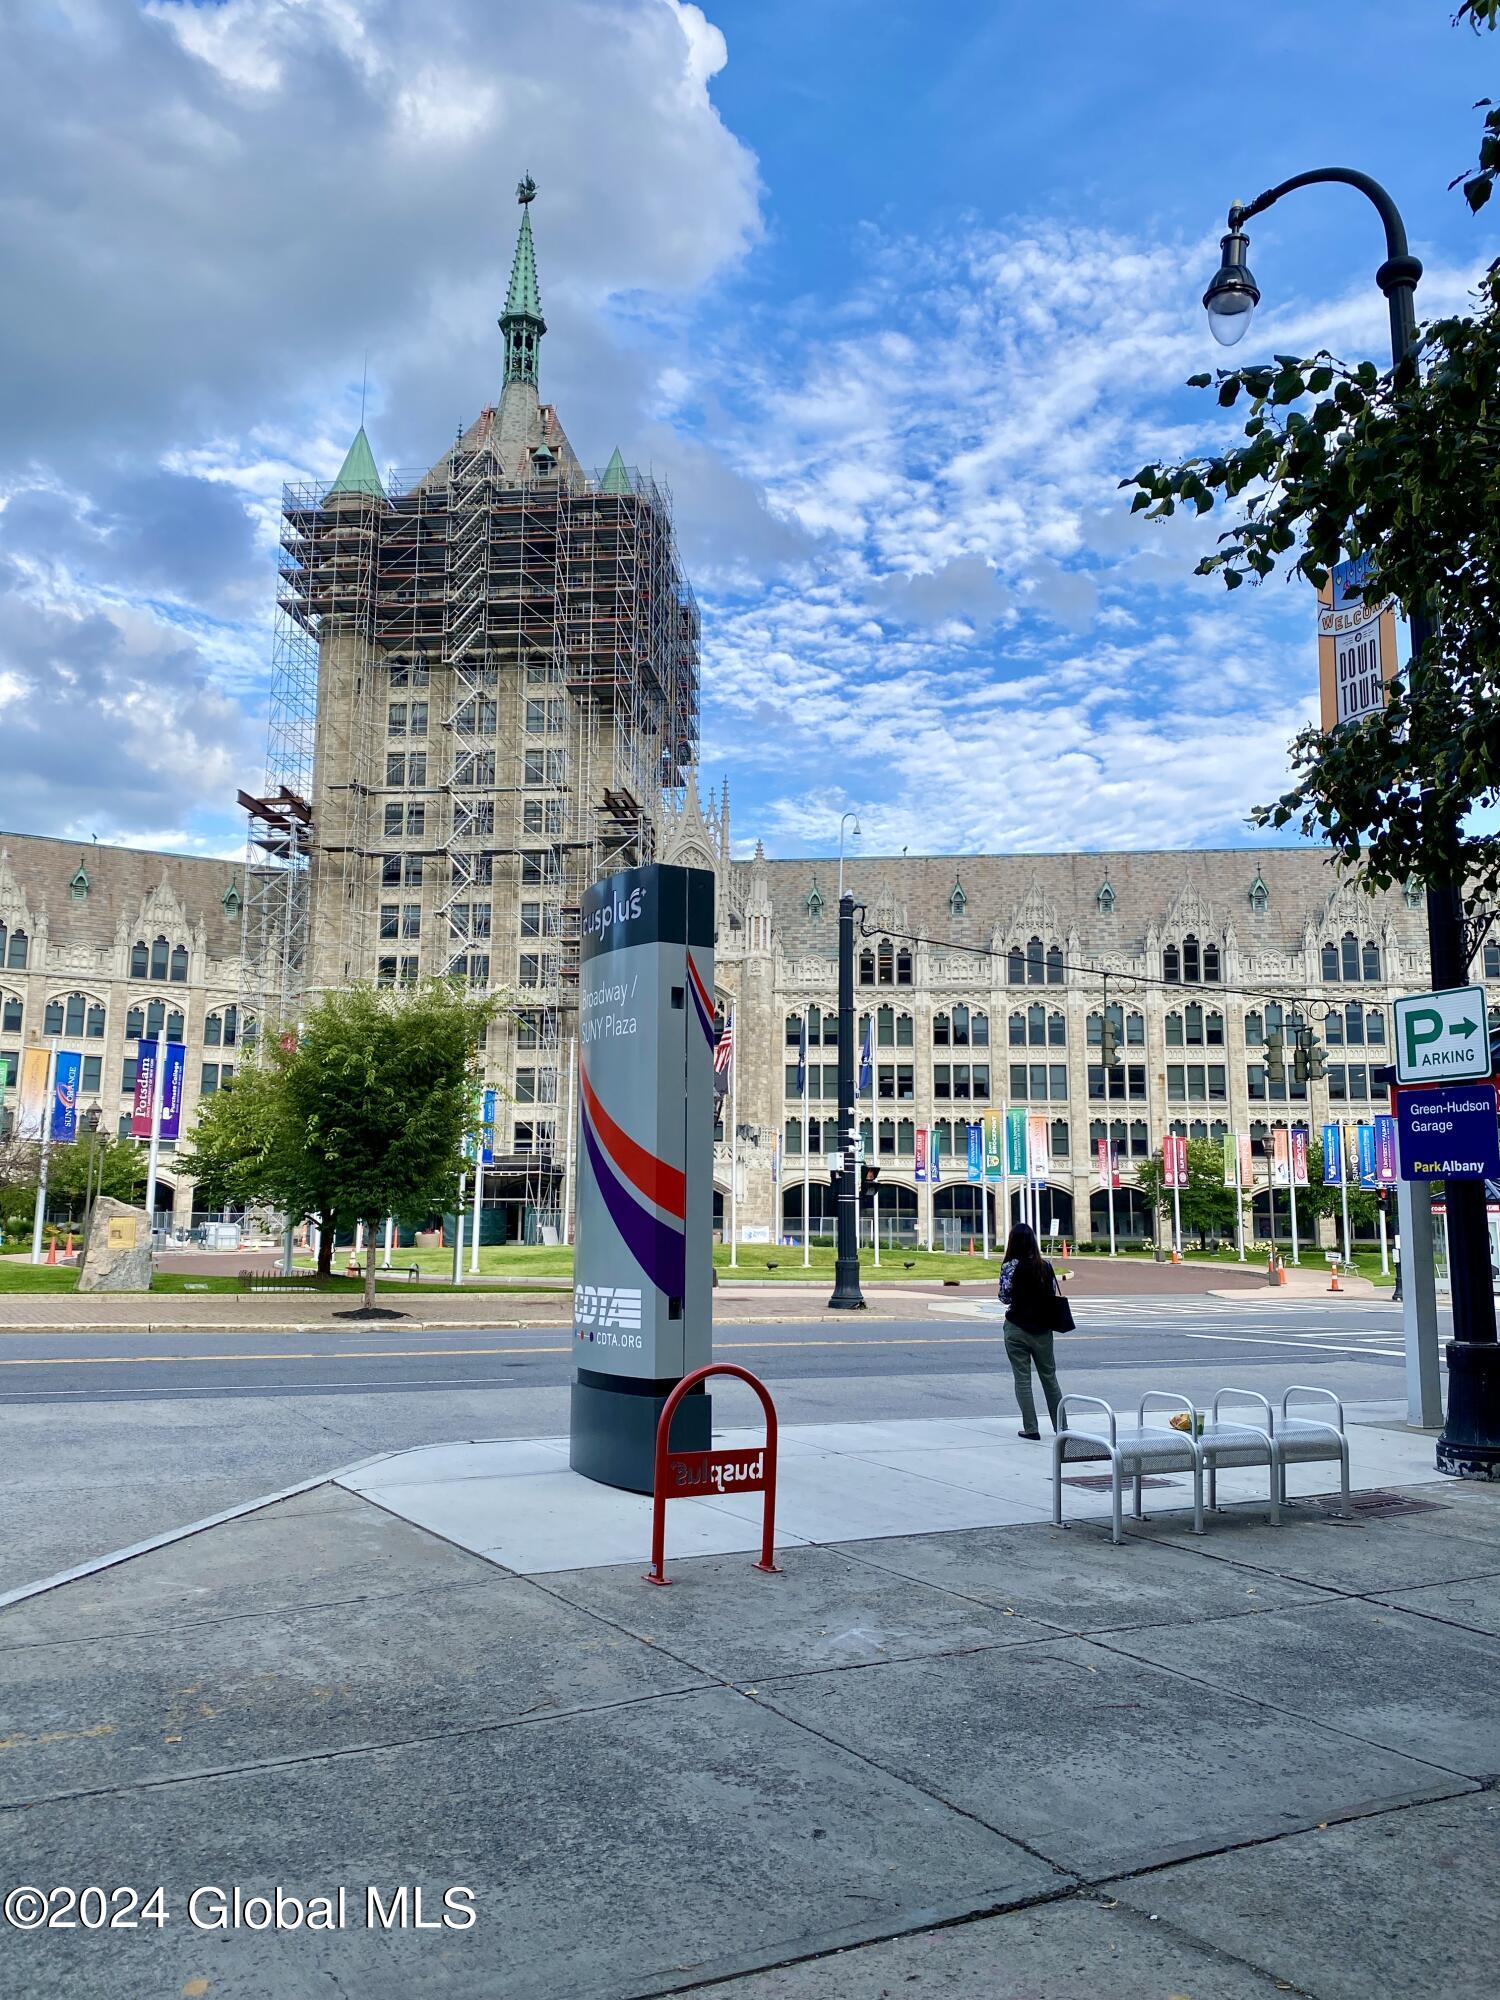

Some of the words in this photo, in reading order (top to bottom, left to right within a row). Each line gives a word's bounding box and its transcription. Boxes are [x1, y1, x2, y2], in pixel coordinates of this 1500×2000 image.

[1322, 600, 1386, 631] WELCO
[1340, 638, 1377, 683] DOWN
[582, 983, 628, 1012] Broadway
[582, 1015, 603, 1044] SUNY
[605, 1014, 637, 1037] Plaza
[66, 1066, 77, 1102] ORANGE
[172, 1061, 180, 1085] College
[134, 1058, 150, 1118] Potsdam
[170, 1086, 178, 1113] Purchase
[64, 1106, 72, 1128] SUNY
[1410, 1100, 1490, 1116] Green-Hudson
[1411, 1120, 1453, 1134] Garage
[1413, 1160, 1485, 1173] ParkAlbany
[574, 1284, 642, 1329] CDTA
[596, 1332, 642, 1348] CDTA.ORG
